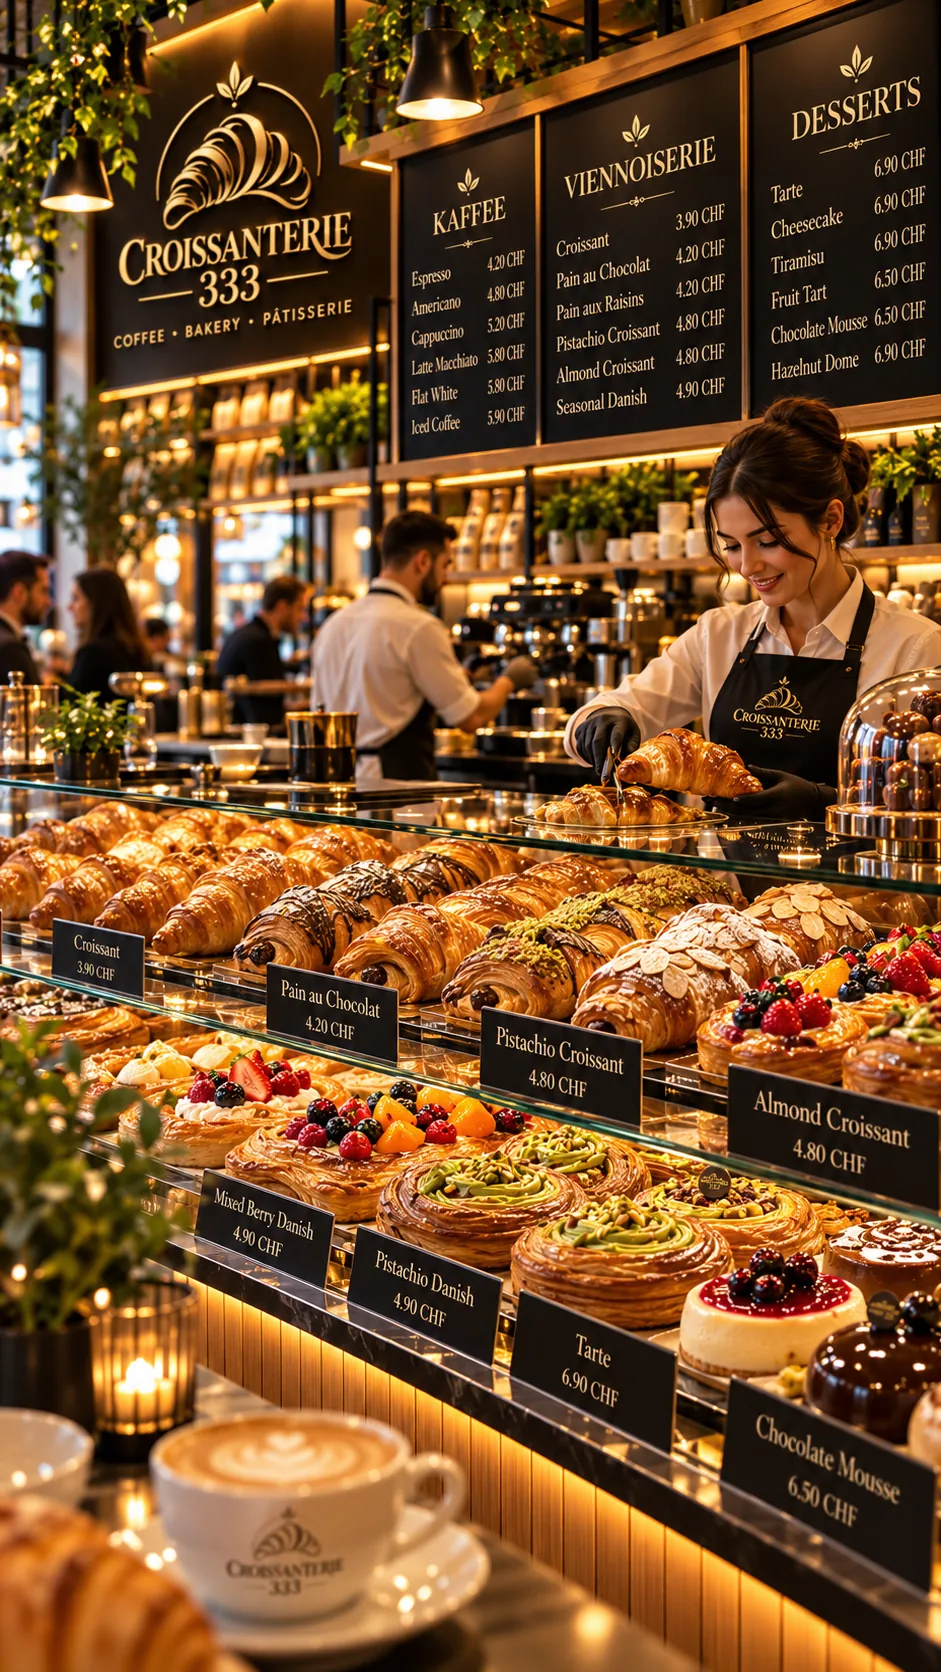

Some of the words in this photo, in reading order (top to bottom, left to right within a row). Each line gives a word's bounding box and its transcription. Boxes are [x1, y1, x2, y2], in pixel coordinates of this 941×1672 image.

[792, 76, 921, 141] DESSERTS
[564, 136, 716, 199] VIENNOISERIE
[770, 184, 803, 204] Tarte
[874, 155, 898, 178] 6.90
[901, 147, 926, 170] CHF
[433, 196, 506, 236] KAFFEE
[556, 233, 610, 257] Croissant
[676, 210, 699, 230] 3.90
[701, 203, 725, 226] CHF
[771, 207, 844, 239] Cheesecake
[874, 192, 898, 214] 6.90
[901, 185, 926, 210] CHF
[119, 211, 352, 286] CROISSANTERIE
[412, 269, 451, 290] Espresso
[487, 254, 505, 272] 4.20
[506, 249, 525, 268] CHF
[557, 268, 580, 289] Pain
[583, 268, 596, 284] au
[599, 256, 650, 280] Chocolat
[676, 244, 699, 264] 4.20
[701, 238, 725, 261] CHF
[771, 249, 824, 274] Tiramisu
[874, 230, 898, 252] 6.90
[901, 223, 926, 248] CHF
[198, 264, 260, 308] 333
[411, 296, 461, 316] Americano
[487, 285, 505, 302] 4.80
[506, 281, 525, 298] CHF
[556, 303, 580, 321] Pain
[582, 302, 602, 316] aux
[605, 291, 644, 312] Raisins
[676, 279, 699, 298] 4.20
[701, 273, 725, 293] CHF
[772, 288, 800, 310] Fruit
[802, 284, 827, 305] Tart
[874, 268, 898, 289] 6.50
[901, 262, 926, 283] CHF
[114, 329, 164, 349] COFFEE
[185, 317, 240, 338] BAKERY
[263, 299, 352, 326] PÂTISSERIE
[411, 324, 464, 348] Cappuccino
[487, 316, 505, 333] 5.20
[506, 312, 525, 330] CHF
[557, 330, 605, 352] Pistachio
[608, 322, 660, 344] Croissant
[676, 313, 699, 332] 4.80
[701, 308, 725, 330] CHF
[771, 320, 825, 344] Chocolate
[828, 315, 868, 335] Mousse
[874, 305, 898, 326] 6.50
[901, 300, 926, 321] CHF
[412, 360, 434, 376] Latte
[435, 353, 478, 372] Macchiato
[487, 346, 505, 364] 5.80
[506, 343, 525, 360] CHF
[556, 361, 600, 384] Almond
[602, 356, 655, 376] Croissant
[676, 347, 699, 368] 4.80
[701, 342, 725, 364] CHF
[772, 358, 822, 380] Hazelnut
[825, 354, 859, 374] Dome
[874, 342, 898, 364] 6.90
[901, 338, 926, 359] CHF
[412, 388, 428, 406] Flat
[430, 386, 458, 404] White
[487, 378, 505, 395] 5.80
[506, 374, 525, 392] CHF
[556, 392, 604, 415] Seasonal
[608, 387, 647, 408] Danish
[676, 380, 699, 399] 4.90
[701, 377, 725, 396] CHF
[412, 419, 430, 435] Iced
[431, 414, 460, 432] Coffee
[487, 408, 505, 426] 5.90
[506, 406, 525, 422] CHF
[733, 708, 820, 734] CROISSANTERIE
[760, 726, 784, 740] 333
[74, 934, 120, 959] Croissant
[77, 960, 95, 976] 3.90
[96, 966, 115, 981] CHF
[281, 980, 306, 1001] Pain
[308, 991, 323, 1005] au
[326, 990, 380, 1018] Chocolat
[305, 1016, 328, 1034] 4.20
[330, 1022, 355, 1040] CHF
[496, 1026, 556, 1058] Pistachio
[559, 1041, 624, 1075] Croissant
[528, 1069, 555, 1090] 4.80
[558, 1076, 587, 1098] CHF
[754, 1090, 821, 1126] Almond
[826, 1107, 910, 1149] Croissant
[793, 1139, 826, 1163] 4.80
[830, 1149, 866, 1174] CHF
[214, 1188, 245, 1213] Mixed
[246, 1202, 276, 1228] Berry
[277, 1211, 314, 1240] Danish
[233, 1226, 256, 1246] 4.90
[258, 1236, 284, 1257] CHF
[375, 1250, 429, 1287] Pistachio
[431, 1273, 474, 1307] Danish
[393, 1292, 418, 1315] 4.90
[420, 1304, 446, 1327] CHF
[576, 1333, 611, 1368] Tarte
[562, 1368, 588, 1393] 6.90
[590, 1381, 619, 1407] CHF
[756, 1412, 835, 1471] Chocolate
[838, 1450, 901, 1506] Mousse
[788, 1476, 820, 1506] 6.50
[823, 1494, 858, 1527] CHF
